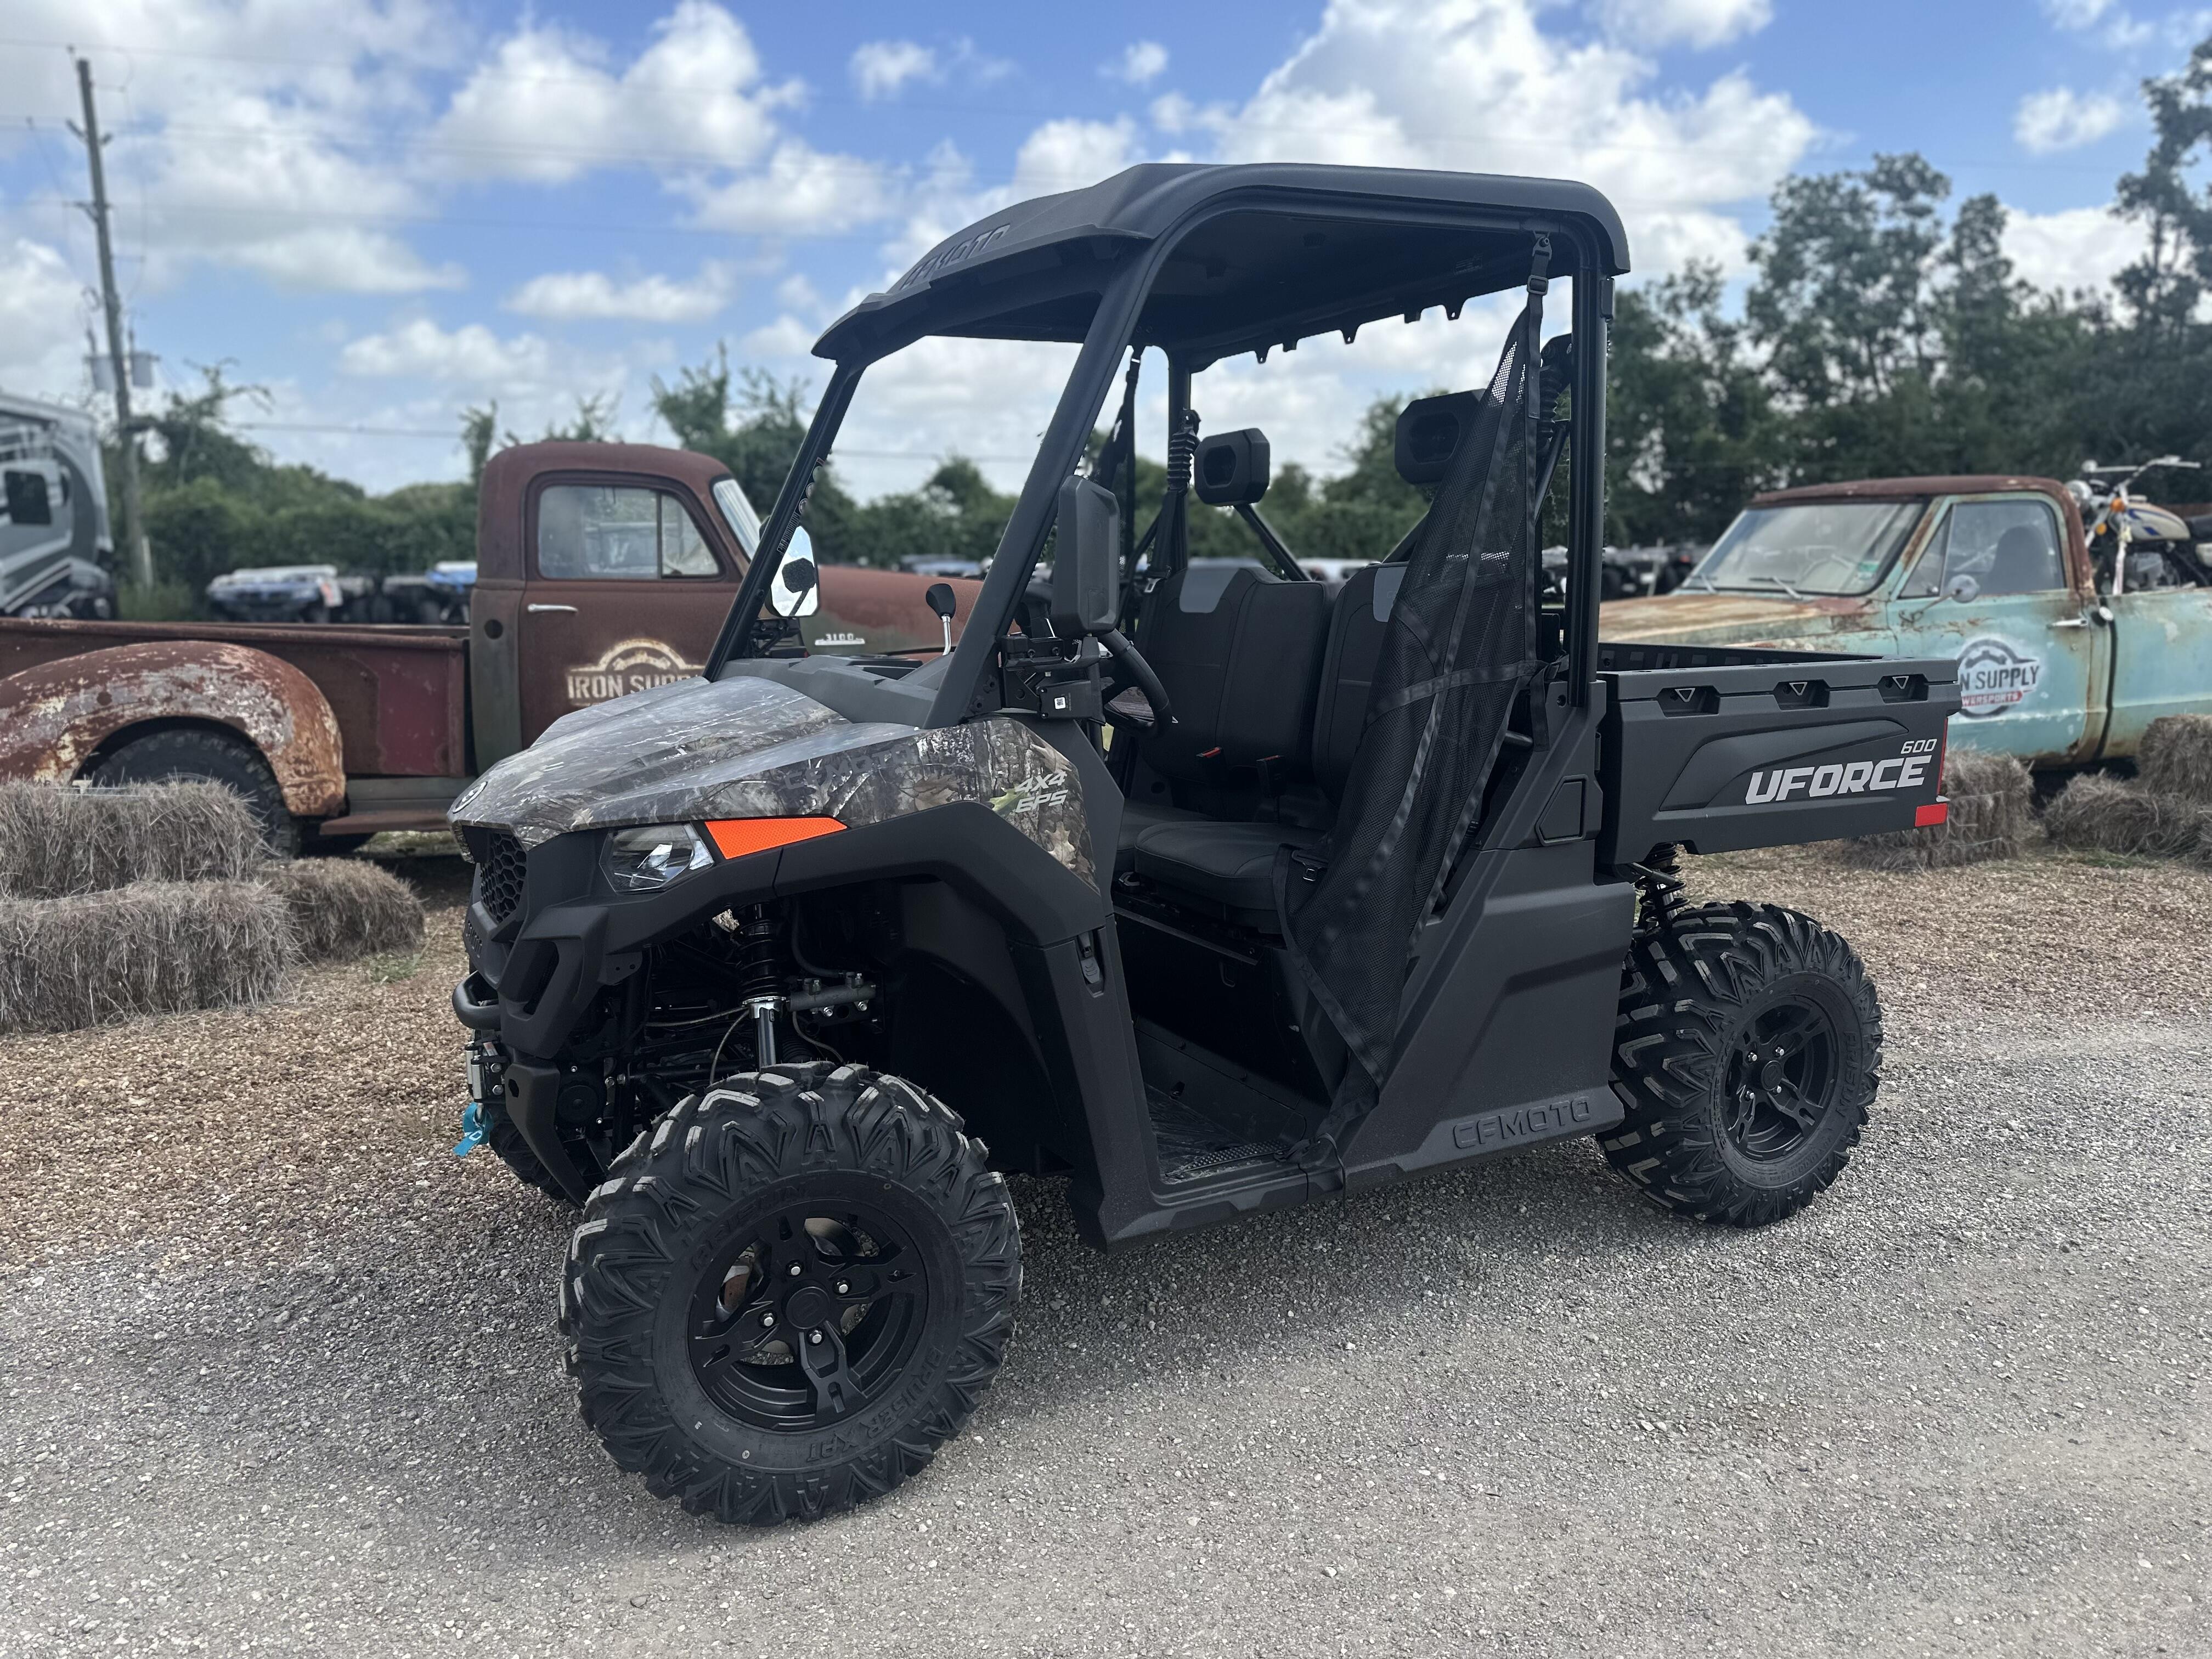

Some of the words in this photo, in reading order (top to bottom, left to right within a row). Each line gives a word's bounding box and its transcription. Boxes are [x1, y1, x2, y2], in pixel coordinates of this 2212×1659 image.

[826, 633, 854, 641] 3100
[567, 675, 624, 698] IRON
[1976, 665, 2039, 690] SUPPLY
[1900, 738, 1937, 754] 600
[785, 744, 915, 790] CFMOTO
[1014, 770, 1068, 794] 4X4
[1745, 755, 1932, 805] UFORCE
[1015, 789, 1069, 813] EPS
[1453, 1096, 1590, 1149] CFMOTO
[859, 1346, 945, 1439] BRUISER
